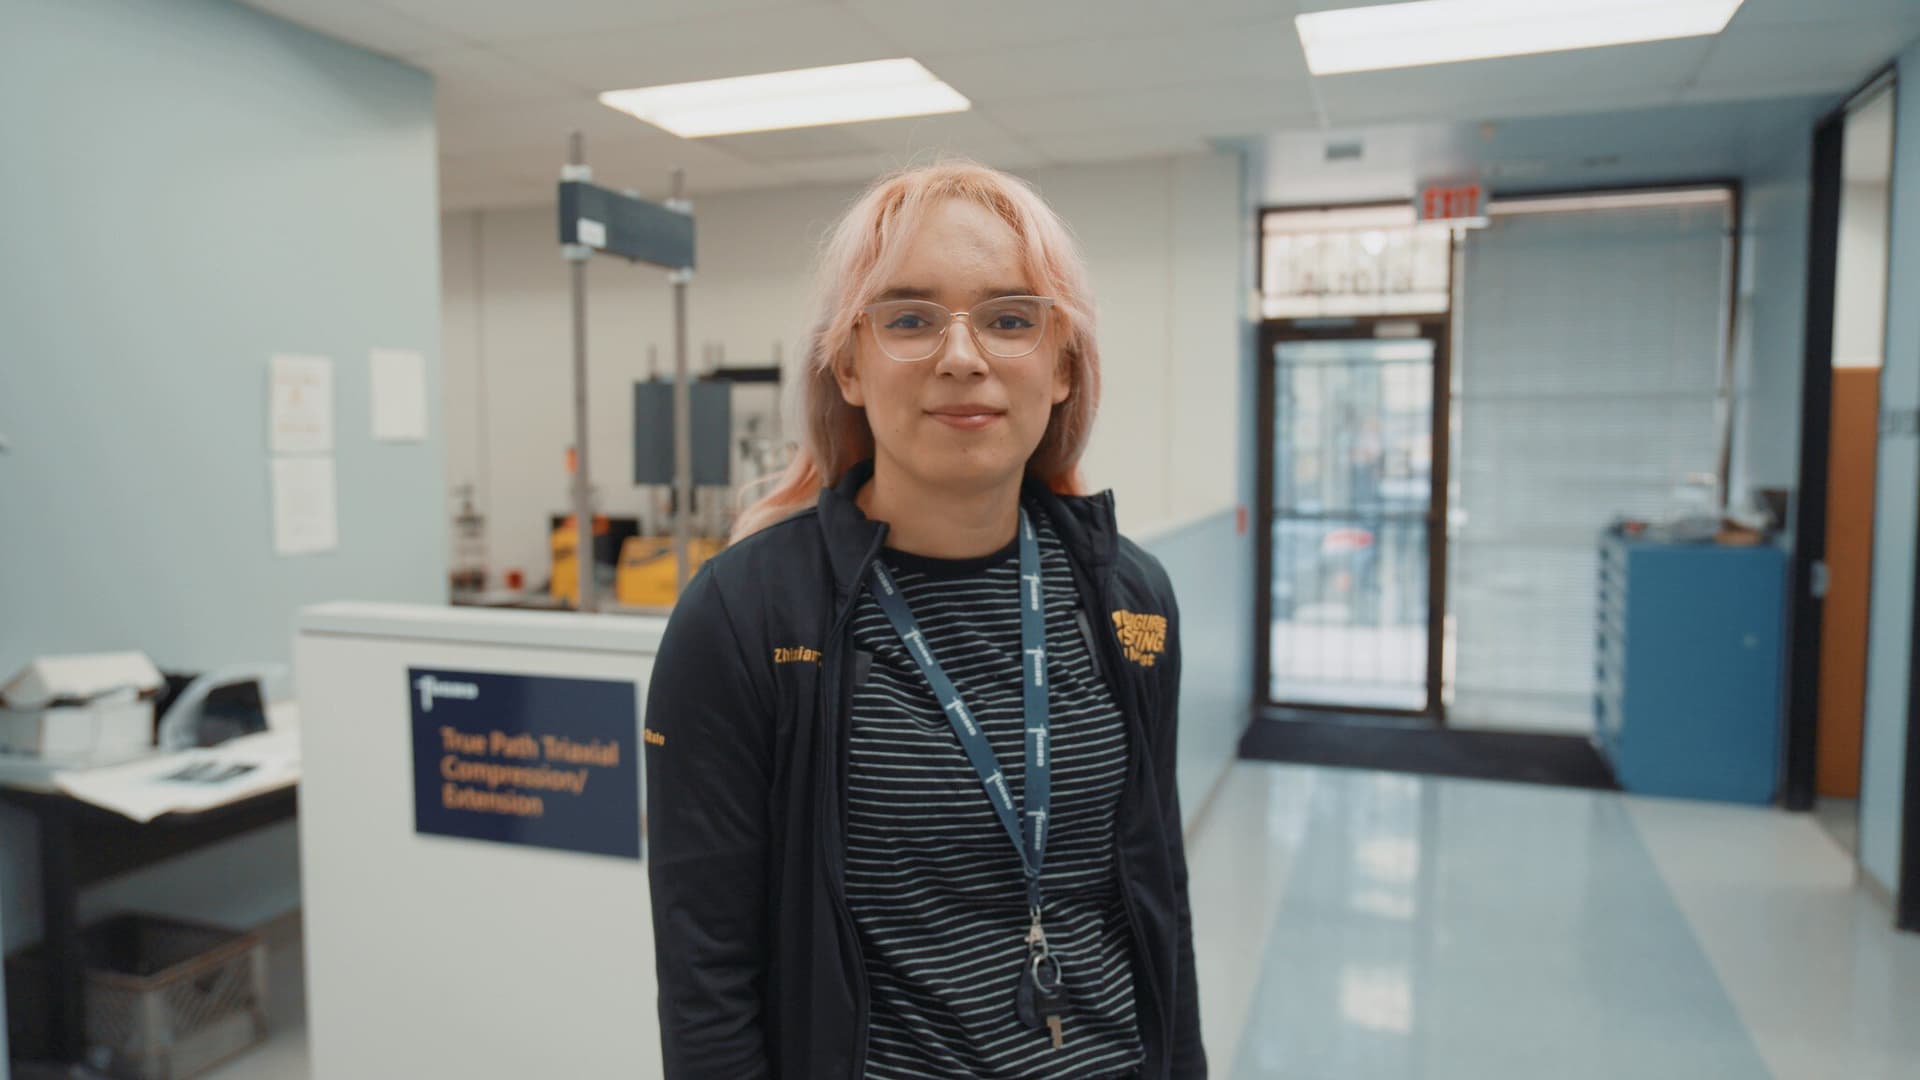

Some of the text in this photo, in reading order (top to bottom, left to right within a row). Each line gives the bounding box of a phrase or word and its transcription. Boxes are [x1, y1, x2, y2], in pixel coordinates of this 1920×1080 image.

[1423, 185, 1481, 220] EXIT
[440, 726, 486, 752] True
[489, 730, 538, 759] Path
[543, 734, 620, 767] Triaxial
[440, 754, 589, 795] Compression/
[441, 783, 544, 817] Extension
